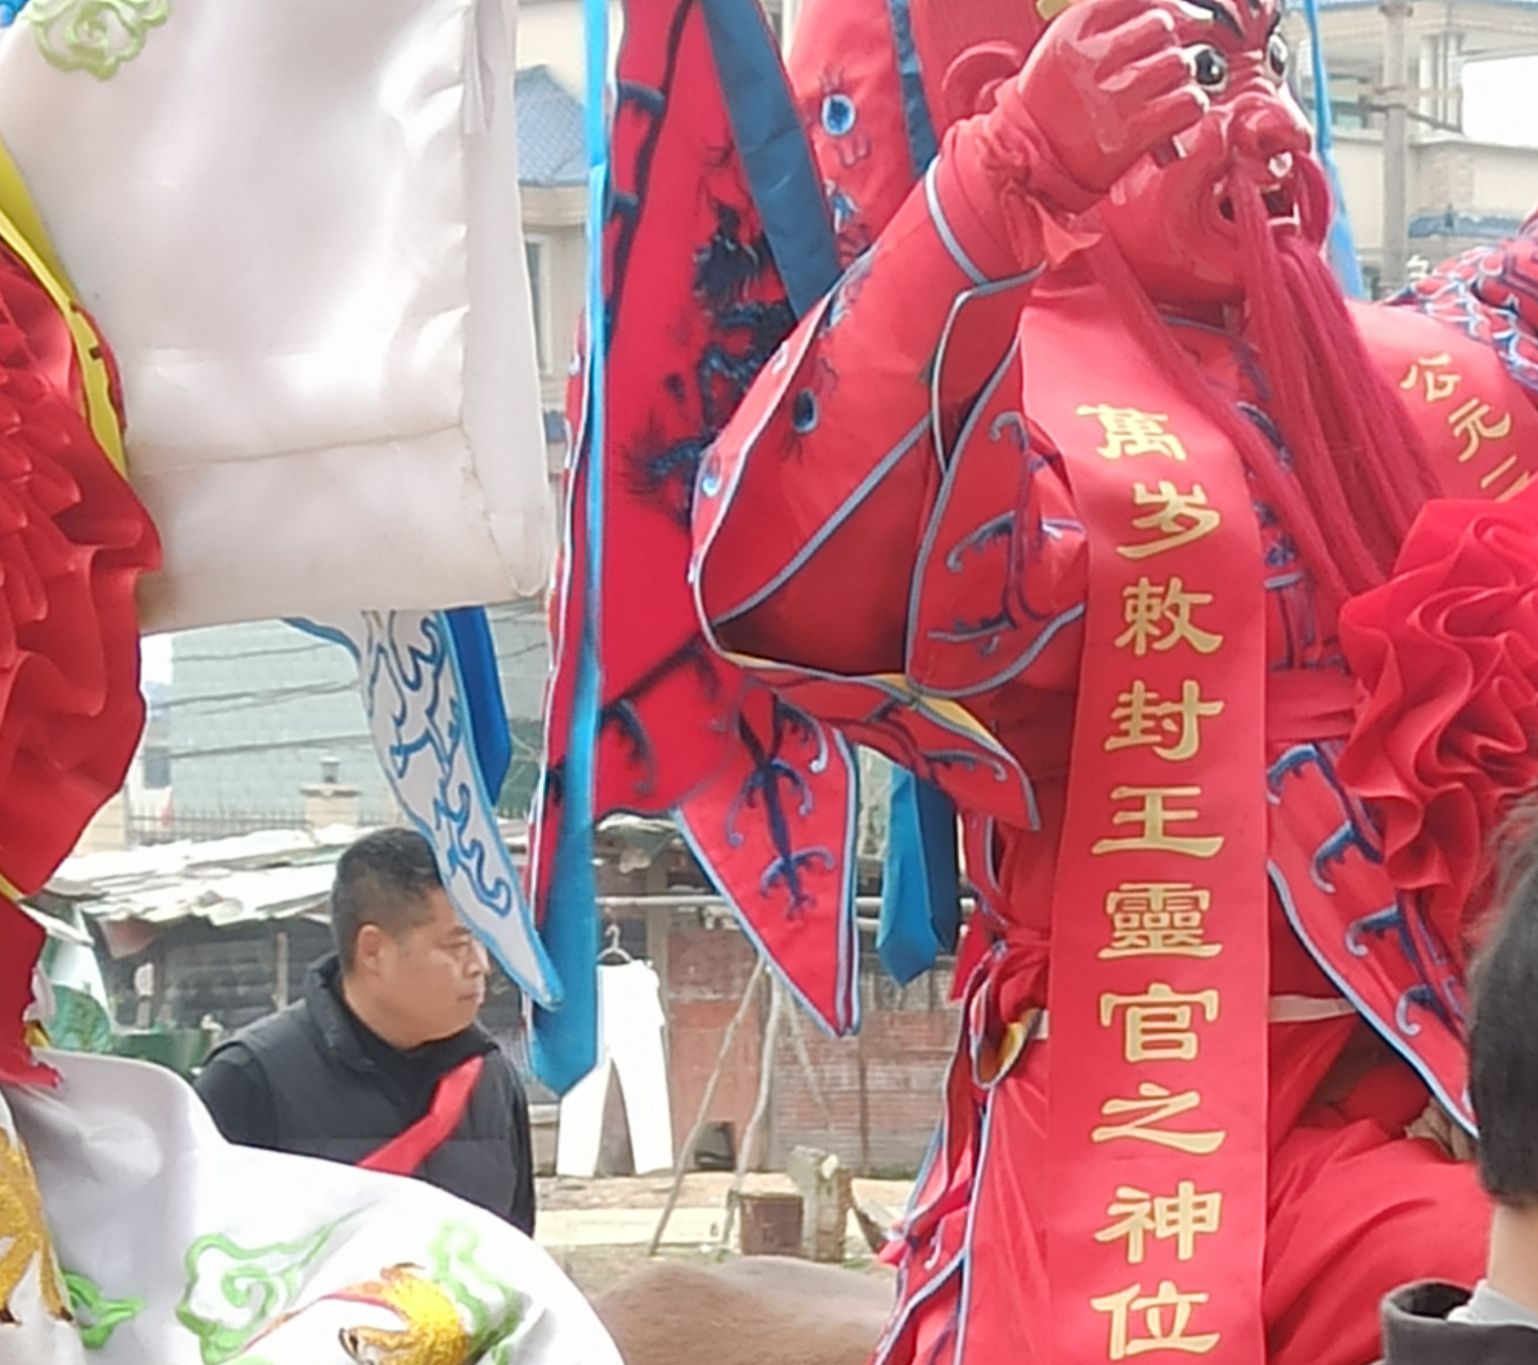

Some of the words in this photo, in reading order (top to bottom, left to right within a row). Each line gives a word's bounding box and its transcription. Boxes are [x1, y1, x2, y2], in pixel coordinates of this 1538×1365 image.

[1075, 403, 1226, 1361] 萬岁敕封王靈官之神位
